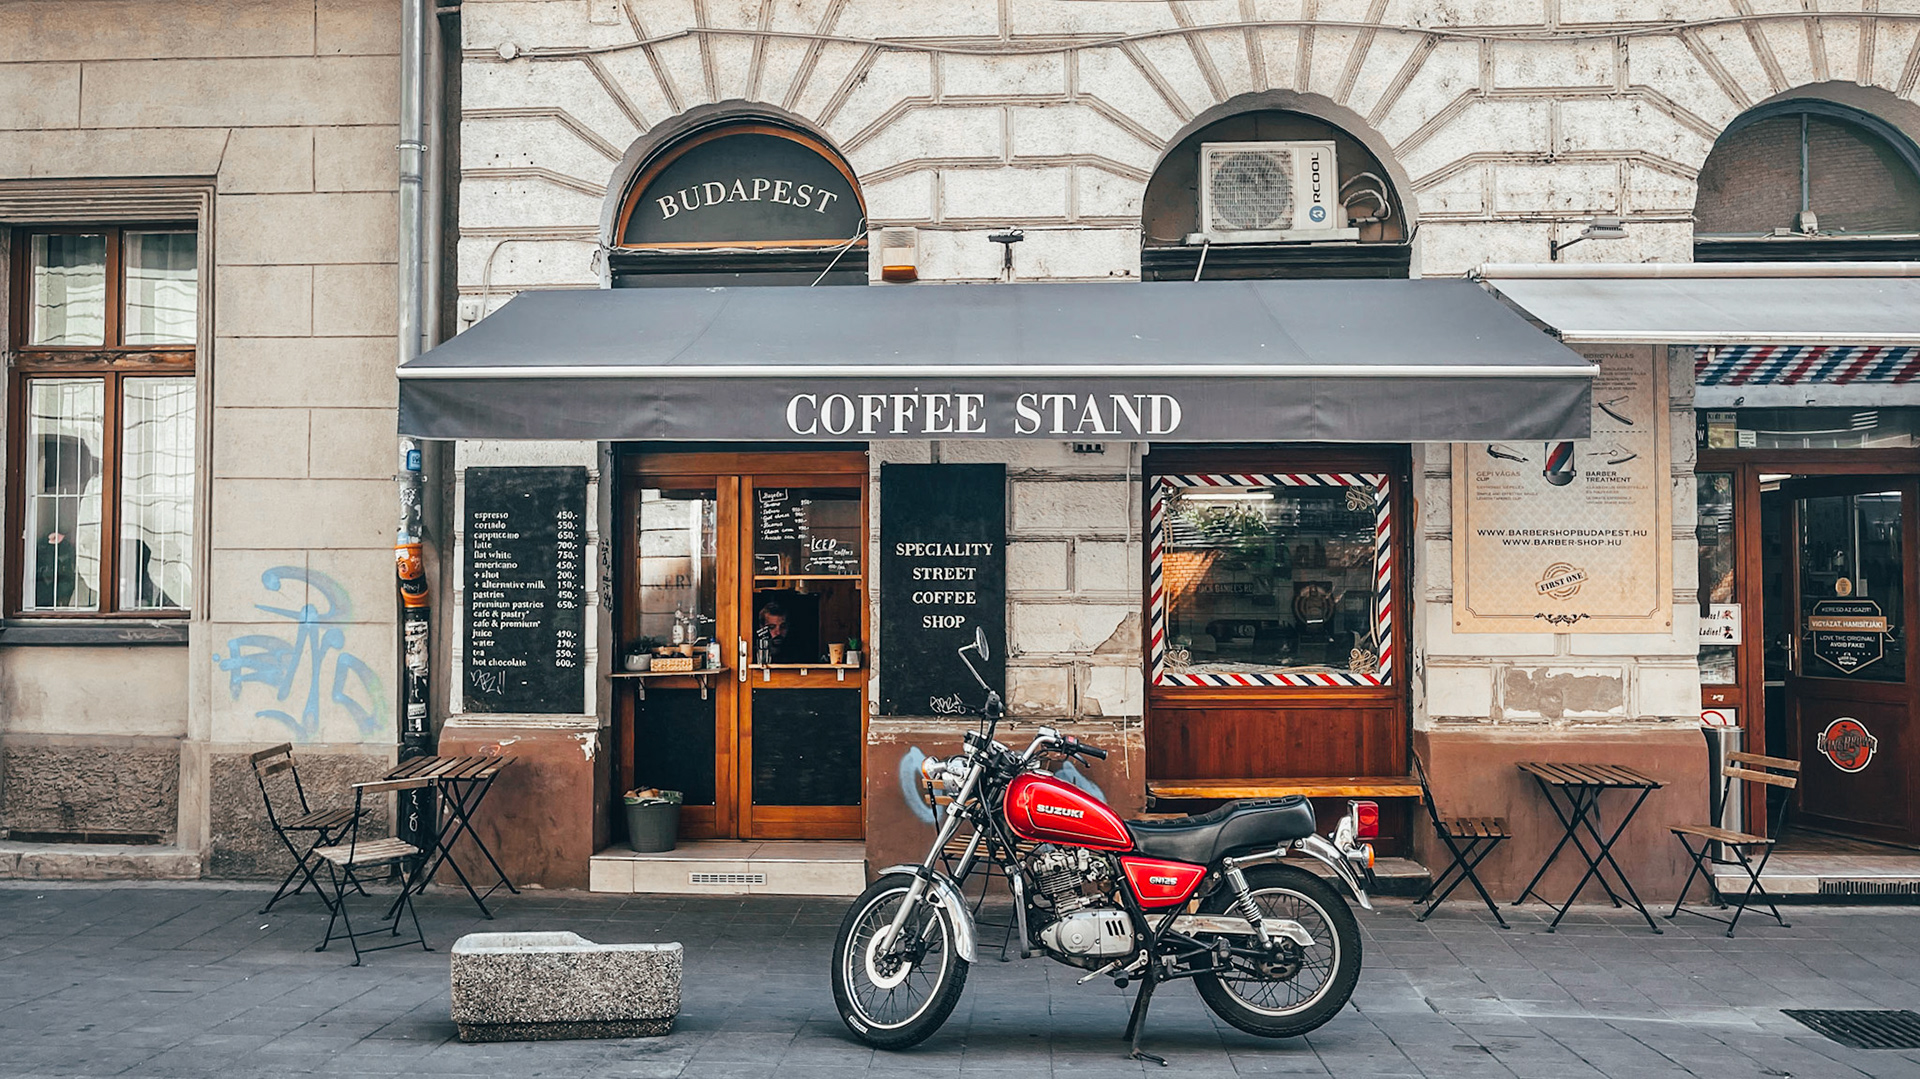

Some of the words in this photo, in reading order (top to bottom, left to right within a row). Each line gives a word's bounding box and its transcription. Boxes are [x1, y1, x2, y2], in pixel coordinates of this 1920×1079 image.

[1311, 152, 1321, 203] RCOOL
[655, 178, 838, 220] BUDAPEST
[785, 392, 986, 435] COFFEE
[1014, 392, 1183, 435] STAND
[474, 512, 509, 521] espresso
[474, 520, 507, 529] cortado
[473, 533, 520, 541] cappuccino
[1477, 529, 1648, 537] WWW.BARBERSHOPBUDAPEST.HU
[474, 540, 492, 548] latte
[896, 543, 993, 556] SPECIALITY
[488, 551, 512, 559] white
[481, 570, 500, 578] shot
[912, 567, 976, 580] STREET
[481, 580, 525, 588] alternative
[1540, 578, 1564, 591] FIRST
[1566, 572, 1584, 583] ONE
[472, 591, 505, 600] pastries
[912, 591, 976, 604] COFFEE
[472, 601, 511, 610] premium
[512, 601, 545, 610] pastries
[923, 615, 965, 628] SHOP
[471, 629, 493, 638] juice
[472, 658, 487, 666] hot
[488, 658, 527, 666] chocolate
[1036, 804, 1084, 819] SUZUKI
